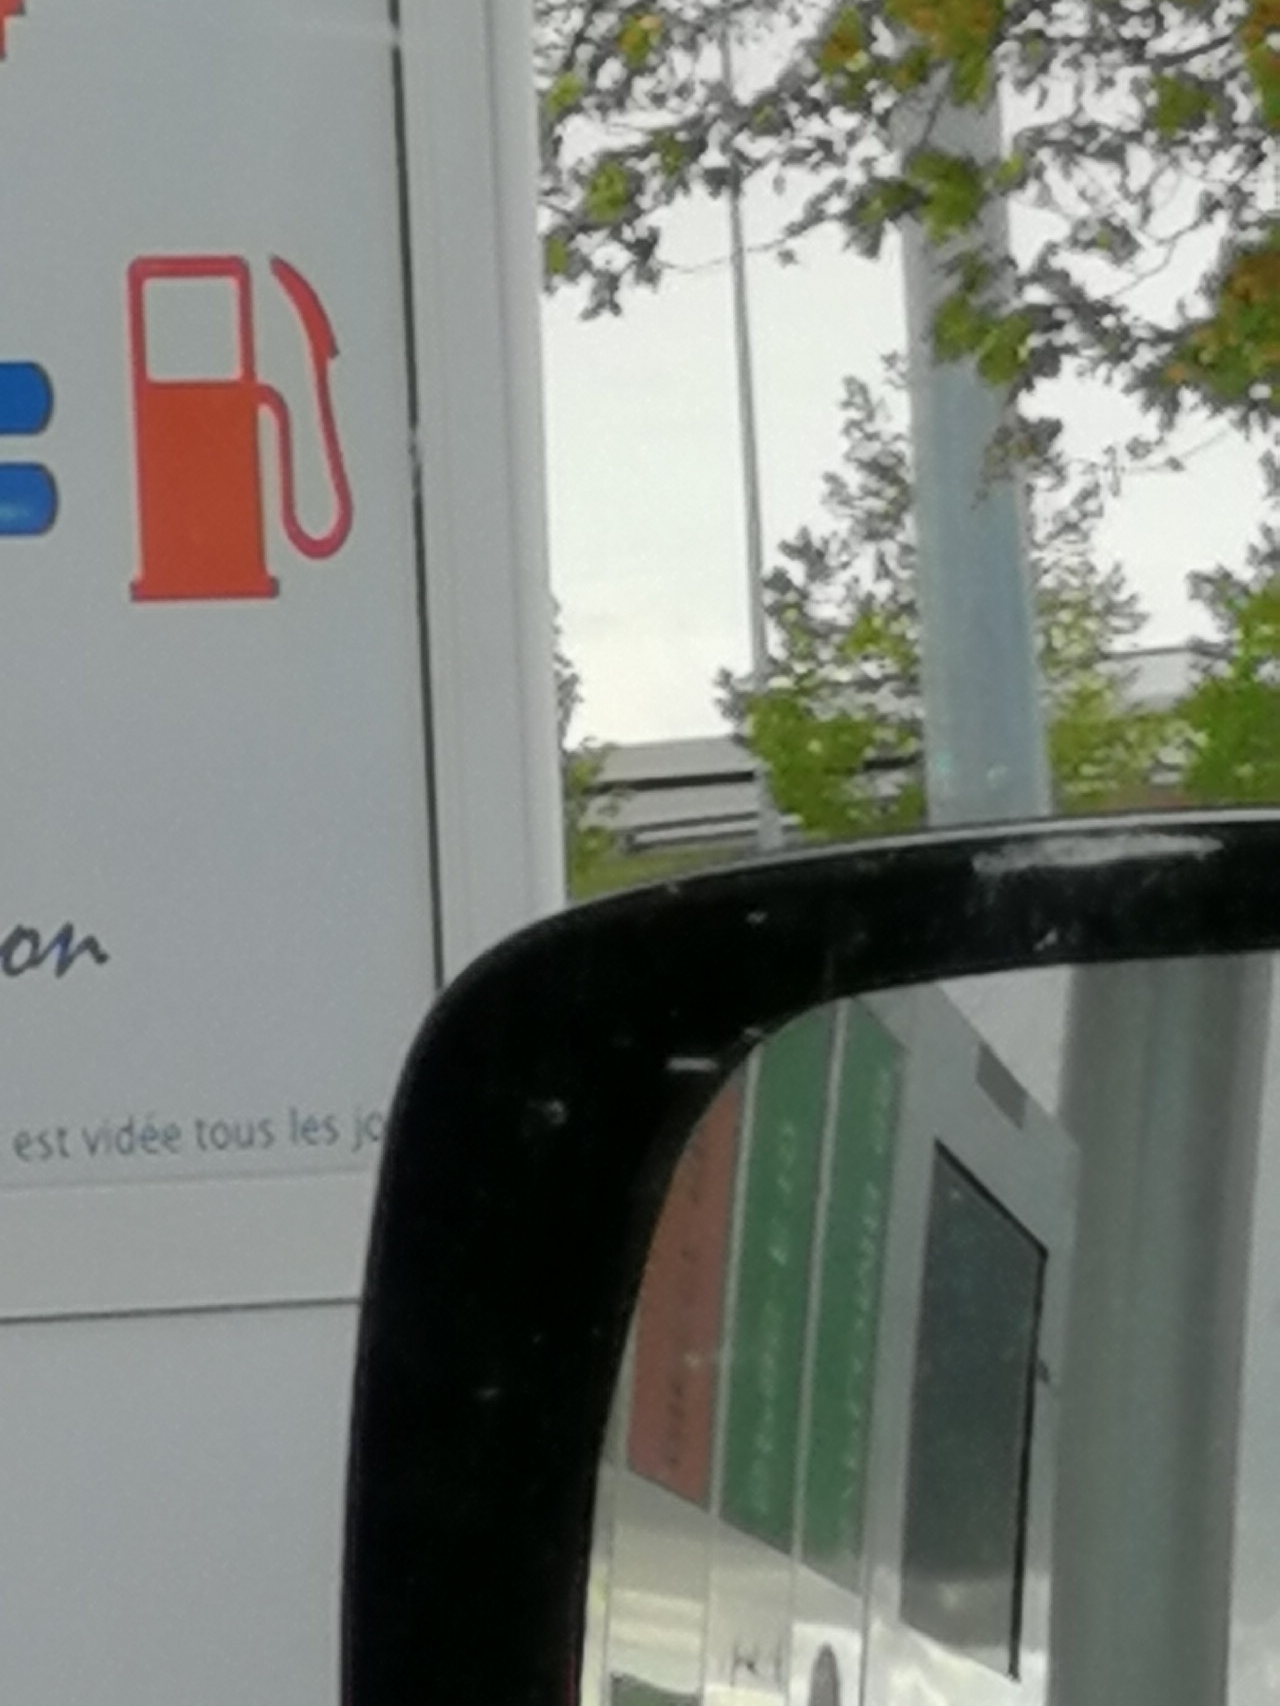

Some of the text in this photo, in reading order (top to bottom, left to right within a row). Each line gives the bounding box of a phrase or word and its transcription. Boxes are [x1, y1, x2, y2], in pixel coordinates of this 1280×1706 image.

[13, 1125, 69, 1161] est
[82, 1111, 180, 1156] vidée
[195, 1117, 274, 1152] tous
[288, 1107, 339, 1146] les
